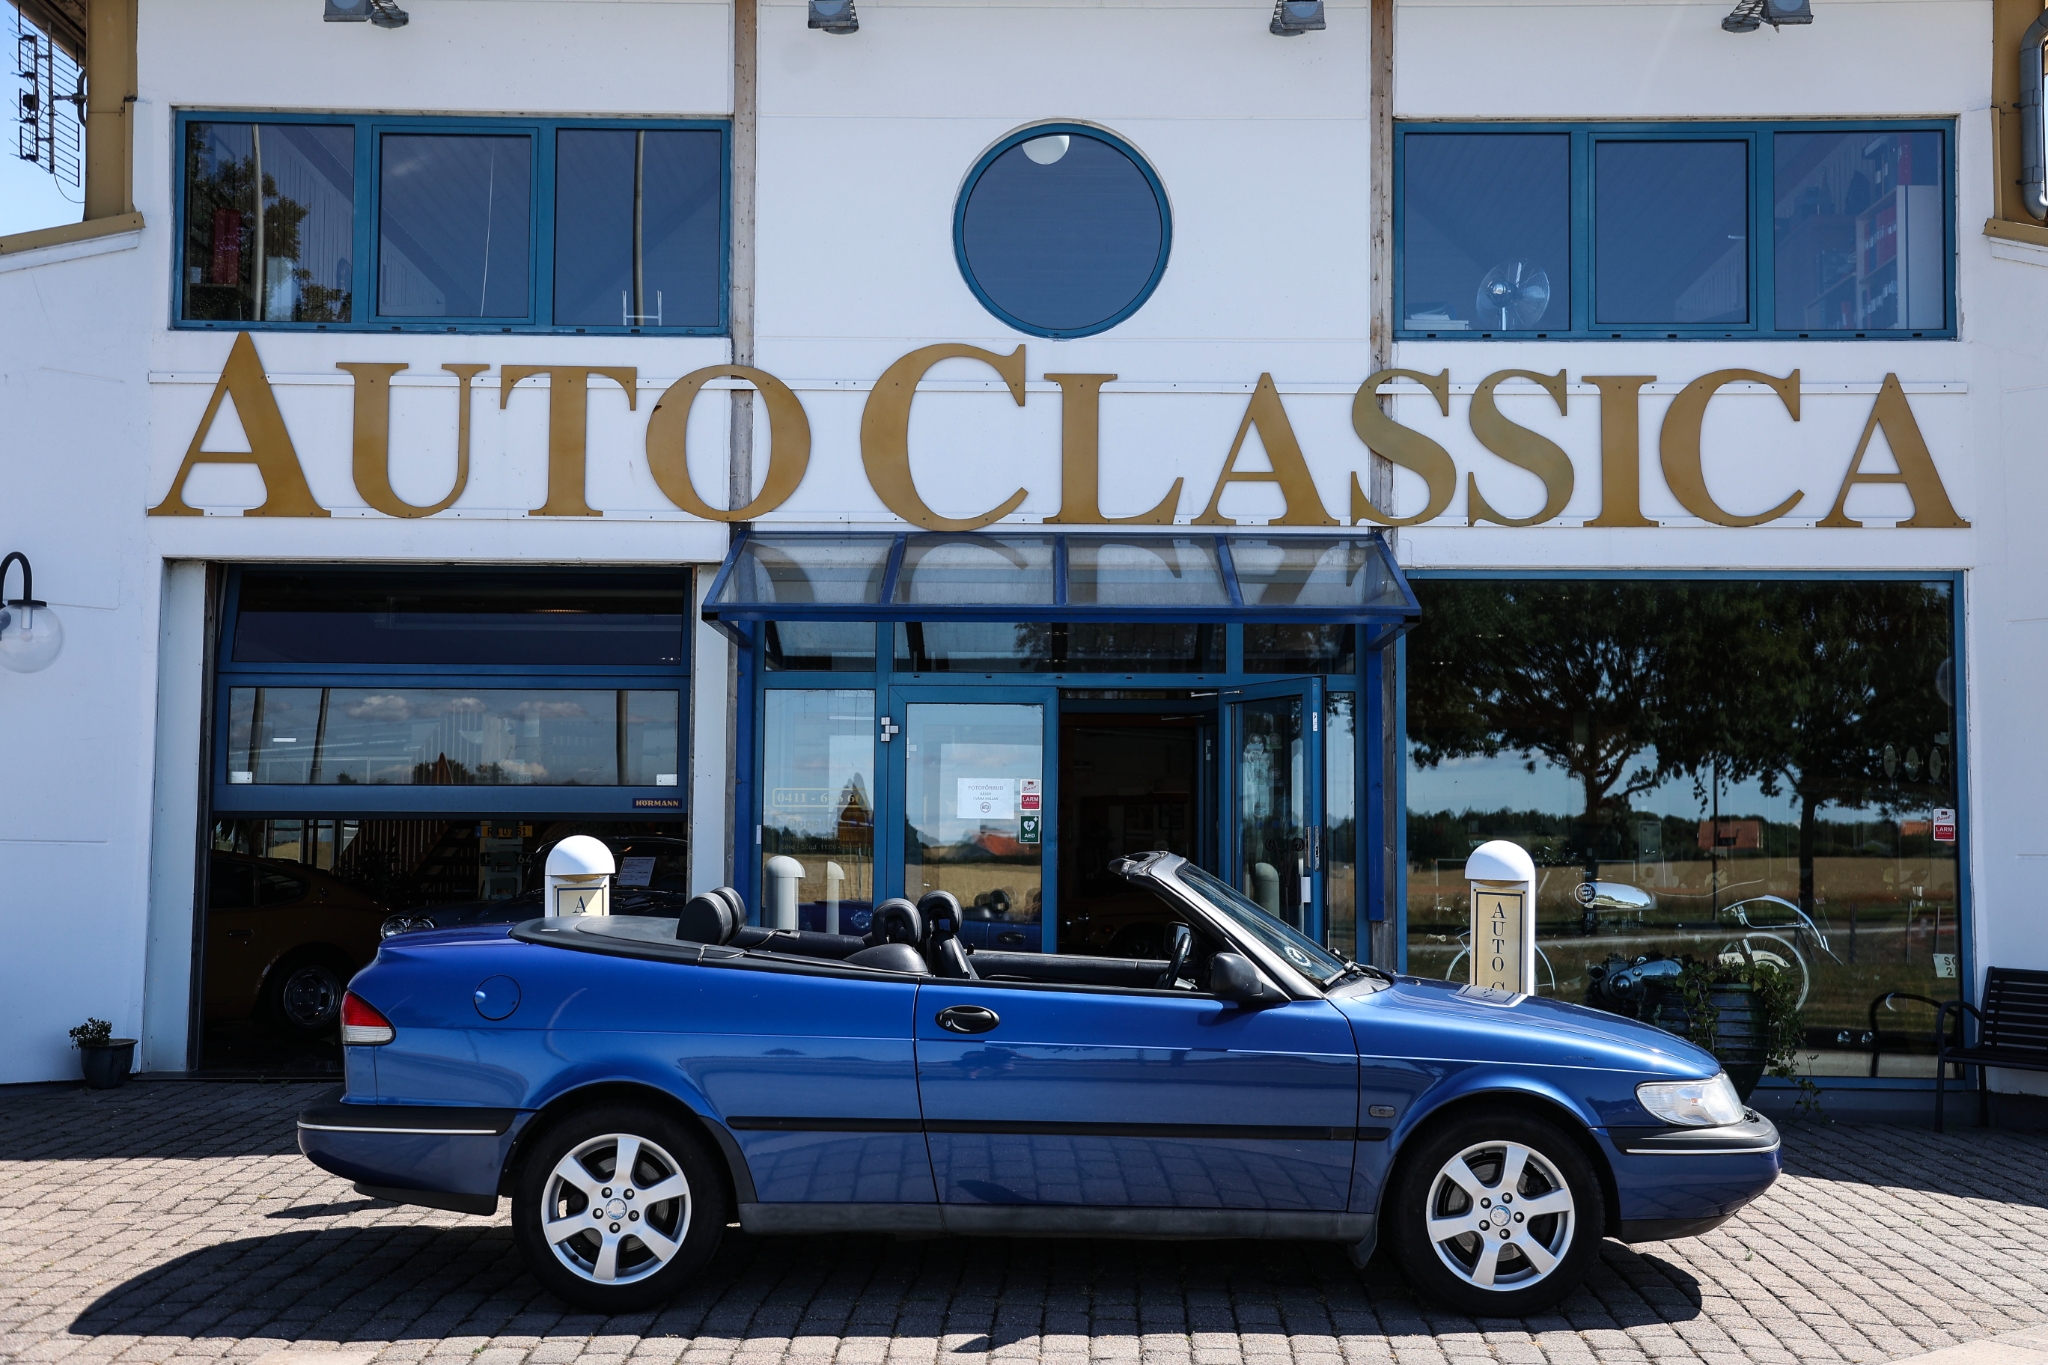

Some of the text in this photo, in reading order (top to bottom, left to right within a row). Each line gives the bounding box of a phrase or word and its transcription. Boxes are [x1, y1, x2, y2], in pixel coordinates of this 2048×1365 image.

[147, 330, 1971, 531] AUTO CLASSICA
[635, 799, 679, 807] HÖRMANN
[777, 793, 806, 802] 0411
[1490, 901, 1507, 973] AUTO
